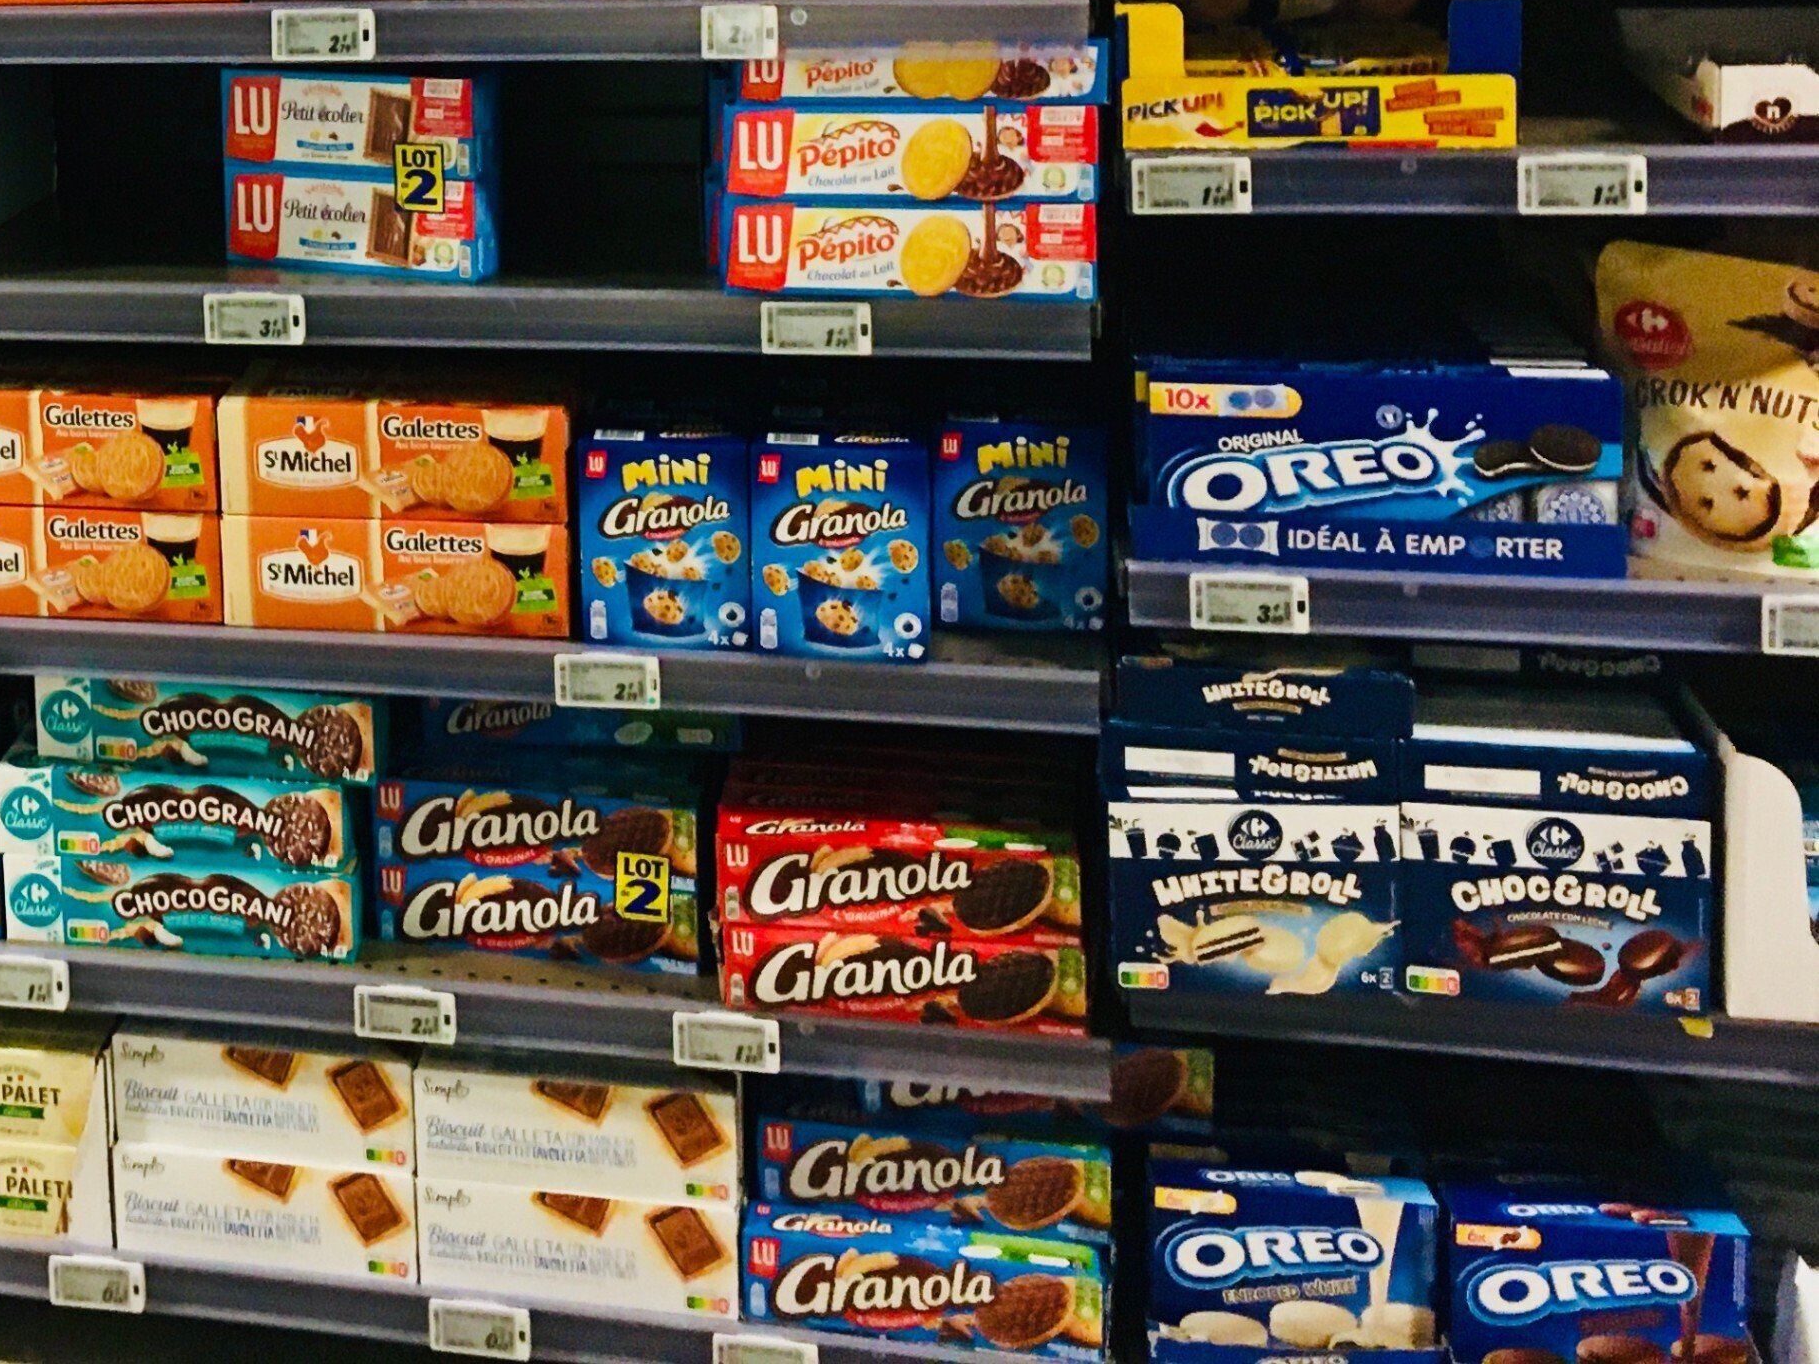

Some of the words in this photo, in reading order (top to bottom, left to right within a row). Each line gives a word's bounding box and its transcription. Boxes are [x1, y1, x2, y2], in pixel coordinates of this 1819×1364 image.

[234, 84, 270, 134] LU
[281, 102, 315, 123] Petit
[318, 104, 365, 123] écolier
[1181, 92, 1224, 112] UP!
[402, 150, 436, 169] LOT
[737, 122, 784, 170] LU
[797, 137, 896, 175] Pépito
[405, 171, 437, 206] 2
[808, 174, 857, 187] Chocolat
[284, 201, 317, 222] Petit
[320, 203, 366, 224] écolier
[737, 216, 782, 264] LU
[797, 231, 895, 270] Pépito
[45, 405, 134, 428] Galettes
[1165, 388, 1210, 410] 10x
[383, 417, 479, 440] Galettes
[1218, 429, 1303, 452] ORIGINAL
[280, 451, 352, 474] Michel
[1182, 443, 1437, 513] OREO
[602, 496, 730, 539] Granola
[957, 480, 1087, 523] Granola
[49, 518, 139, 541] Galettes
[775, 502, 908, 546] Granola
[1287, 526, 1364, 552] IDÉAL
[1376, 525, 1396, 553] À
[387, 531, 483, 554] Galettes
[282, 565, 354, 586] Michel
[1203, 677, 1331, 705] WHITE&ROLL
[142, 708, 315, 749] CHOCOGRANI
[103, 796, 284, 835] CHOCOGRANI
[402, 790, 600, 857] Granola
[624, 858, 662, 880] LOT
[750, 851, 971, 917] Granola
[1152, 867, 1362, 906] WHITE&ROLL
[114, 888, 293, 925] CHOCOGRANI
[403, 874, 599, 939] Granola
[625, 882, 662, 917] 2
[1450, 875, 1661, 918] CHOC&ROLL
[755, 944, 976, 1004] Granola
[2, 1083, 59, 1106] PALET
[789, 1139, 1004, 1199] Granola
[1207, 1168, 1290, 1184] OREO
[1508, 1203, 1594, 1217] OREO
[1176, 1232, 1383, 1279] OREO
[1477, 1264, 1697, 1310] OREO
